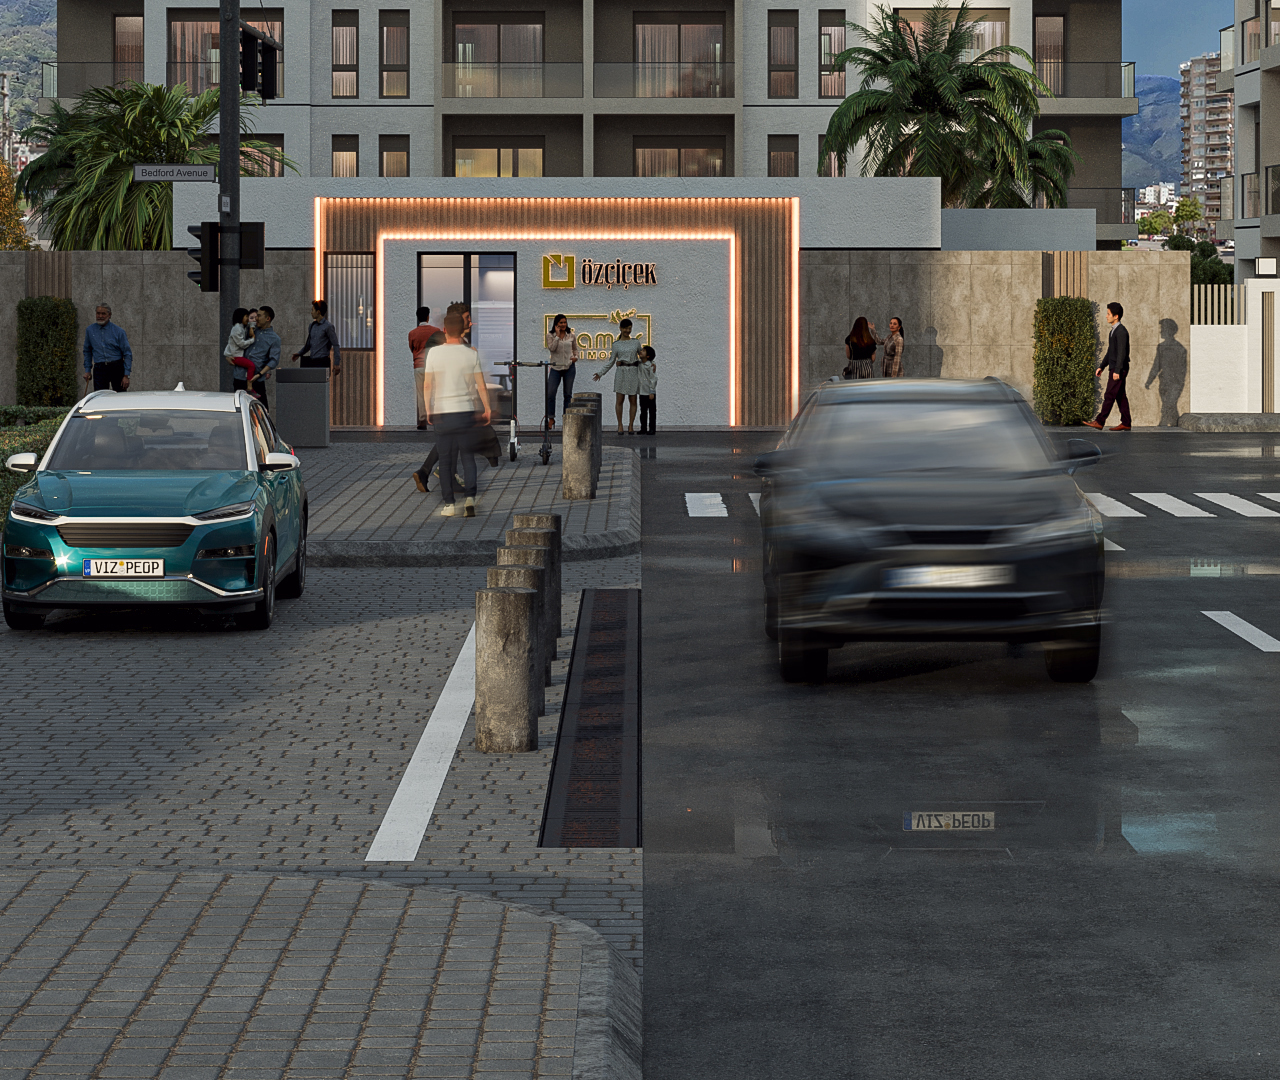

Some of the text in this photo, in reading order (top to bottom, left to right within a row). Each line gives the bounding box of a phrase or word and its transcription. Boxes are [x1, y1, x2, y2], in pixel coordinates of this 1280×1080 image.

[141, 168, 208, 177] Bedford Avenue
[95, 561, 118, 574] VIZ
